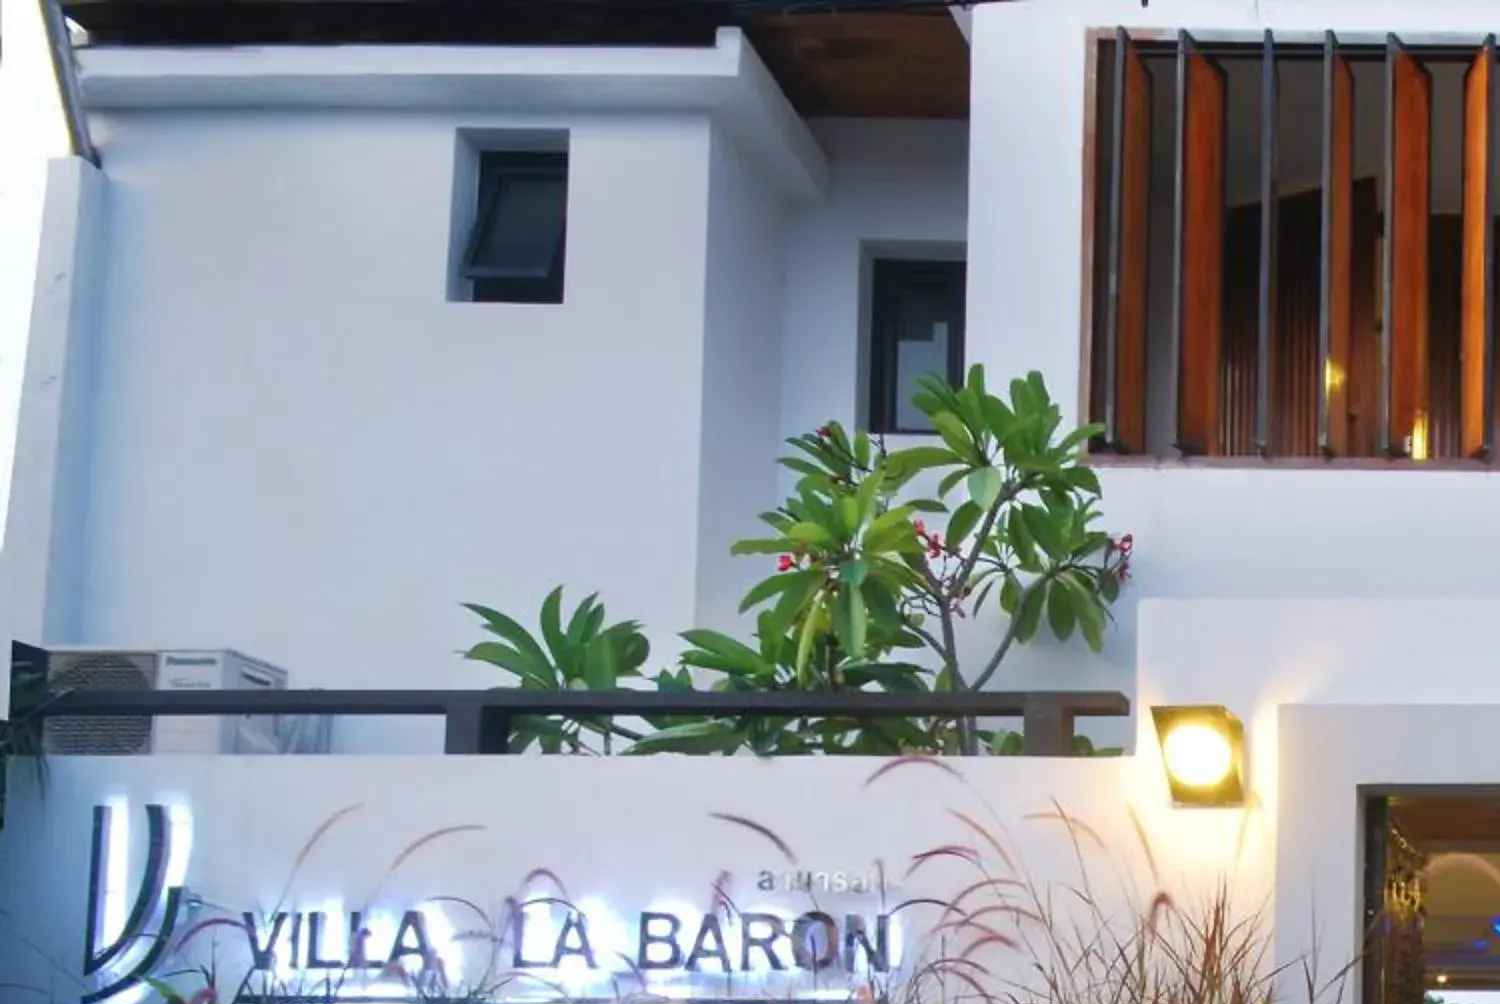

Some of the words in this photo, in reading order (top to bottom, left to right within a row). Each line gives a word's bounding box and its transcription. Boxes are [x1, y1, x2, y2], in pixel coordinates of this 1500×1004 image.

[243, 911, 437, 970] VILLA
[512, 910, 599, 969] LA
[638, 910, 891, 972] BARON
